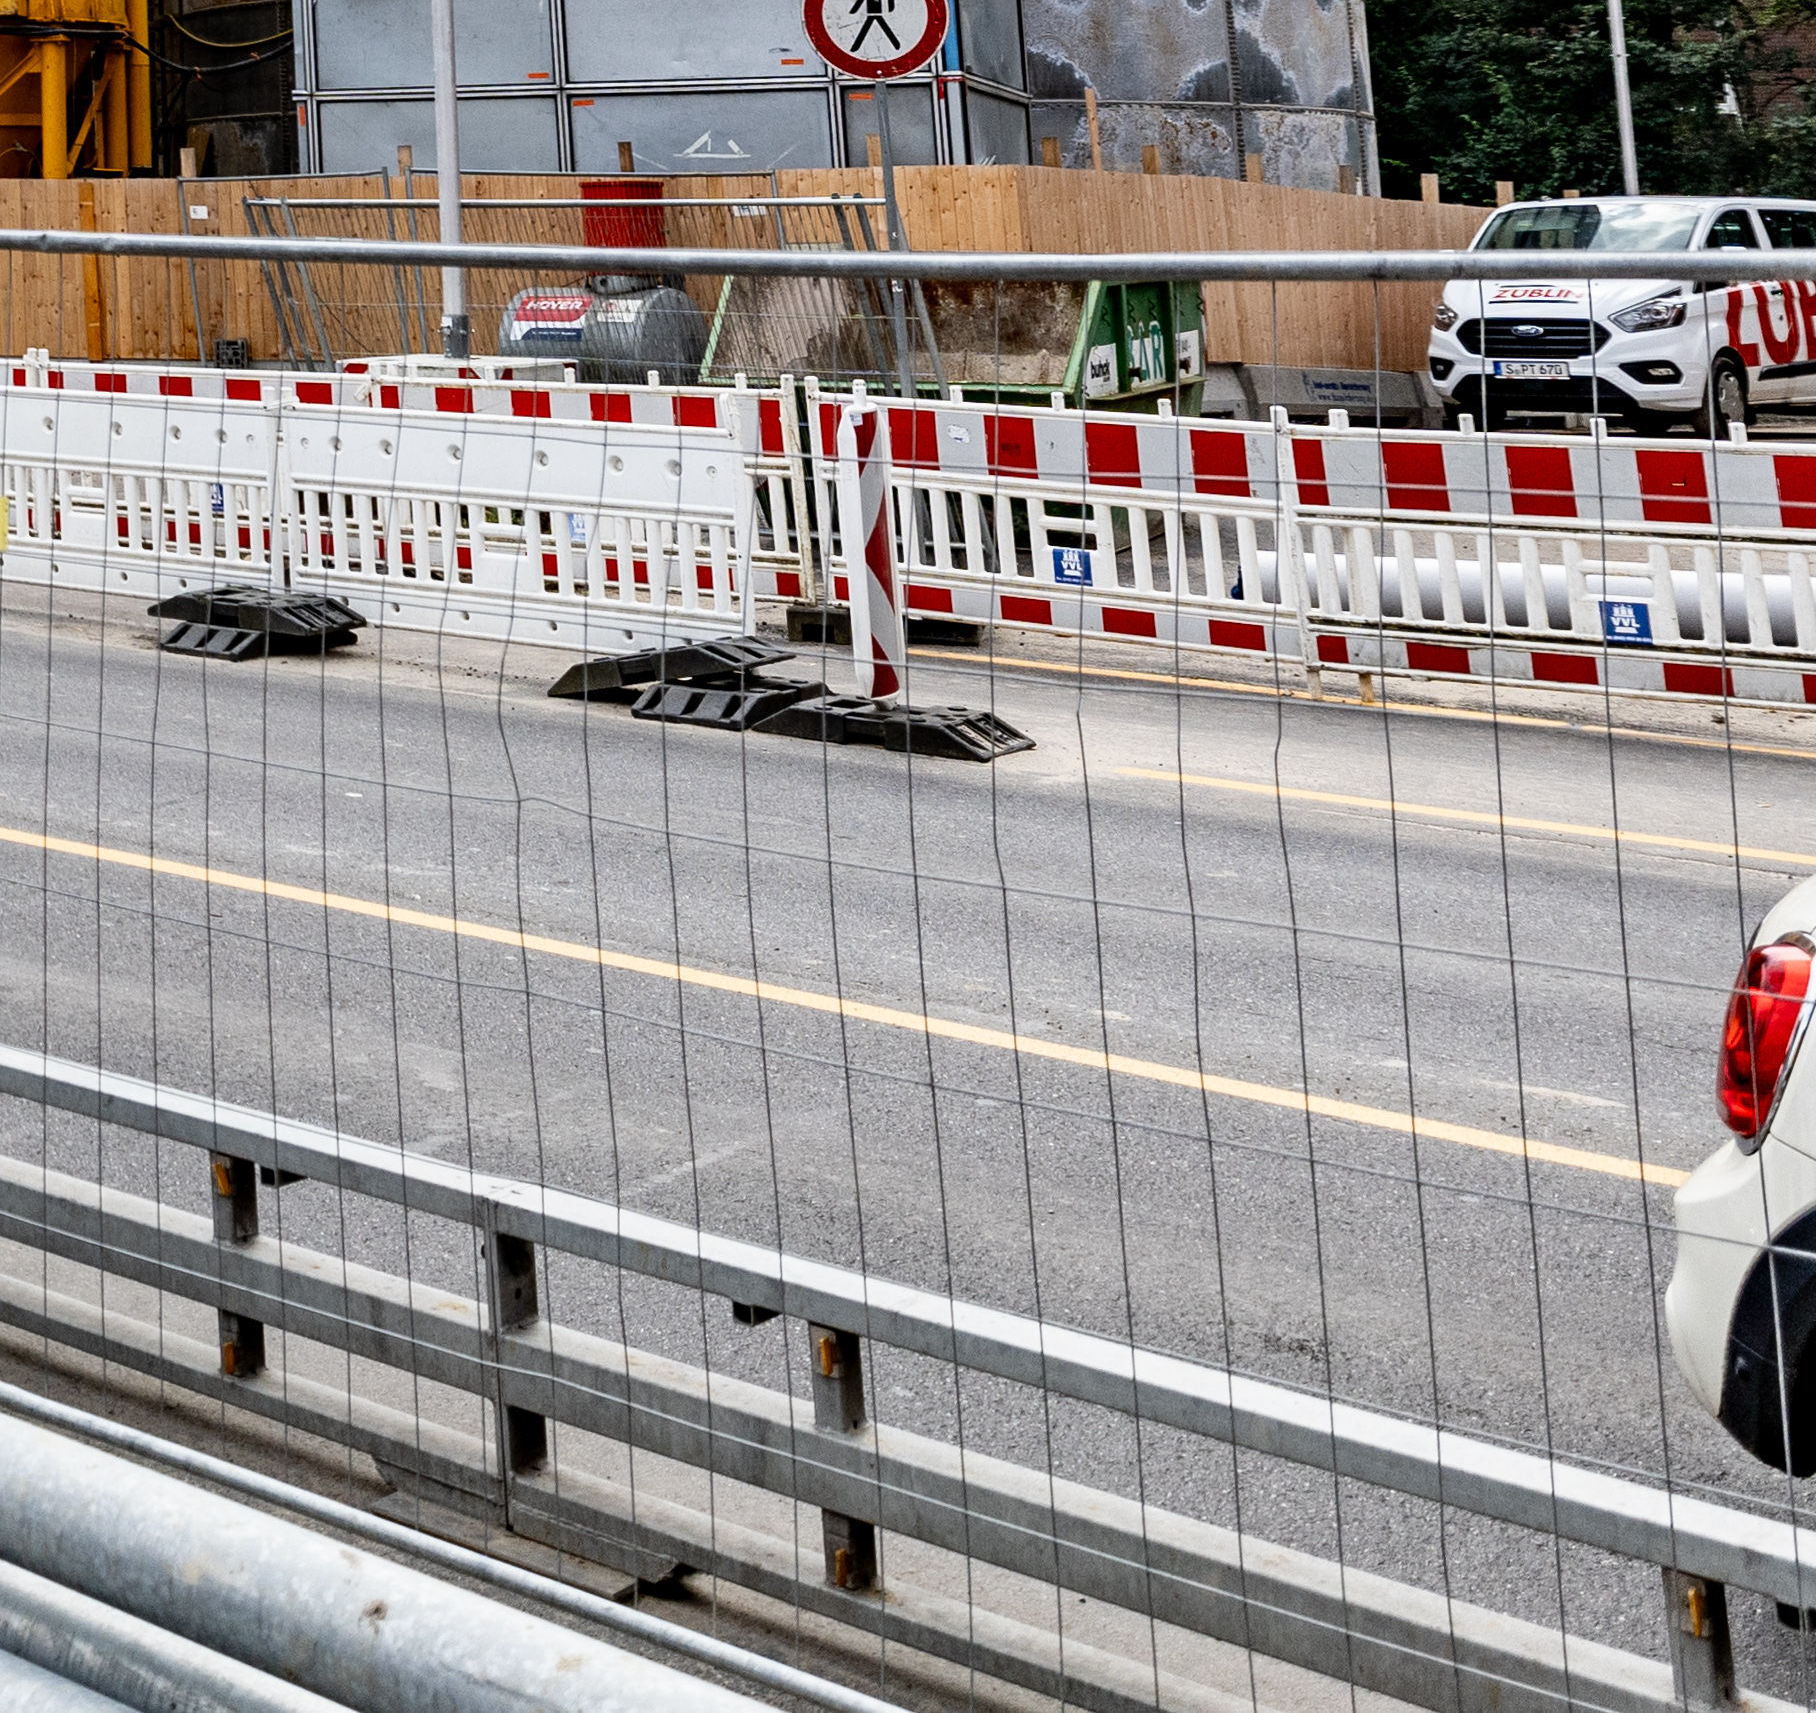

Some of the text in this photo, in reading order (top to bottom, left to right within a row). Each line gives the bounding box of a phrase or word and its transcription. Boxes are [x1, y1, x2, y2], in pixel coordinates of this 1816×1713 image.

[526, 300, 584, 310] HOYER
[1506, 363, 1563, 375] S PT 670
[1610, 616, 1641, 628] VVL
